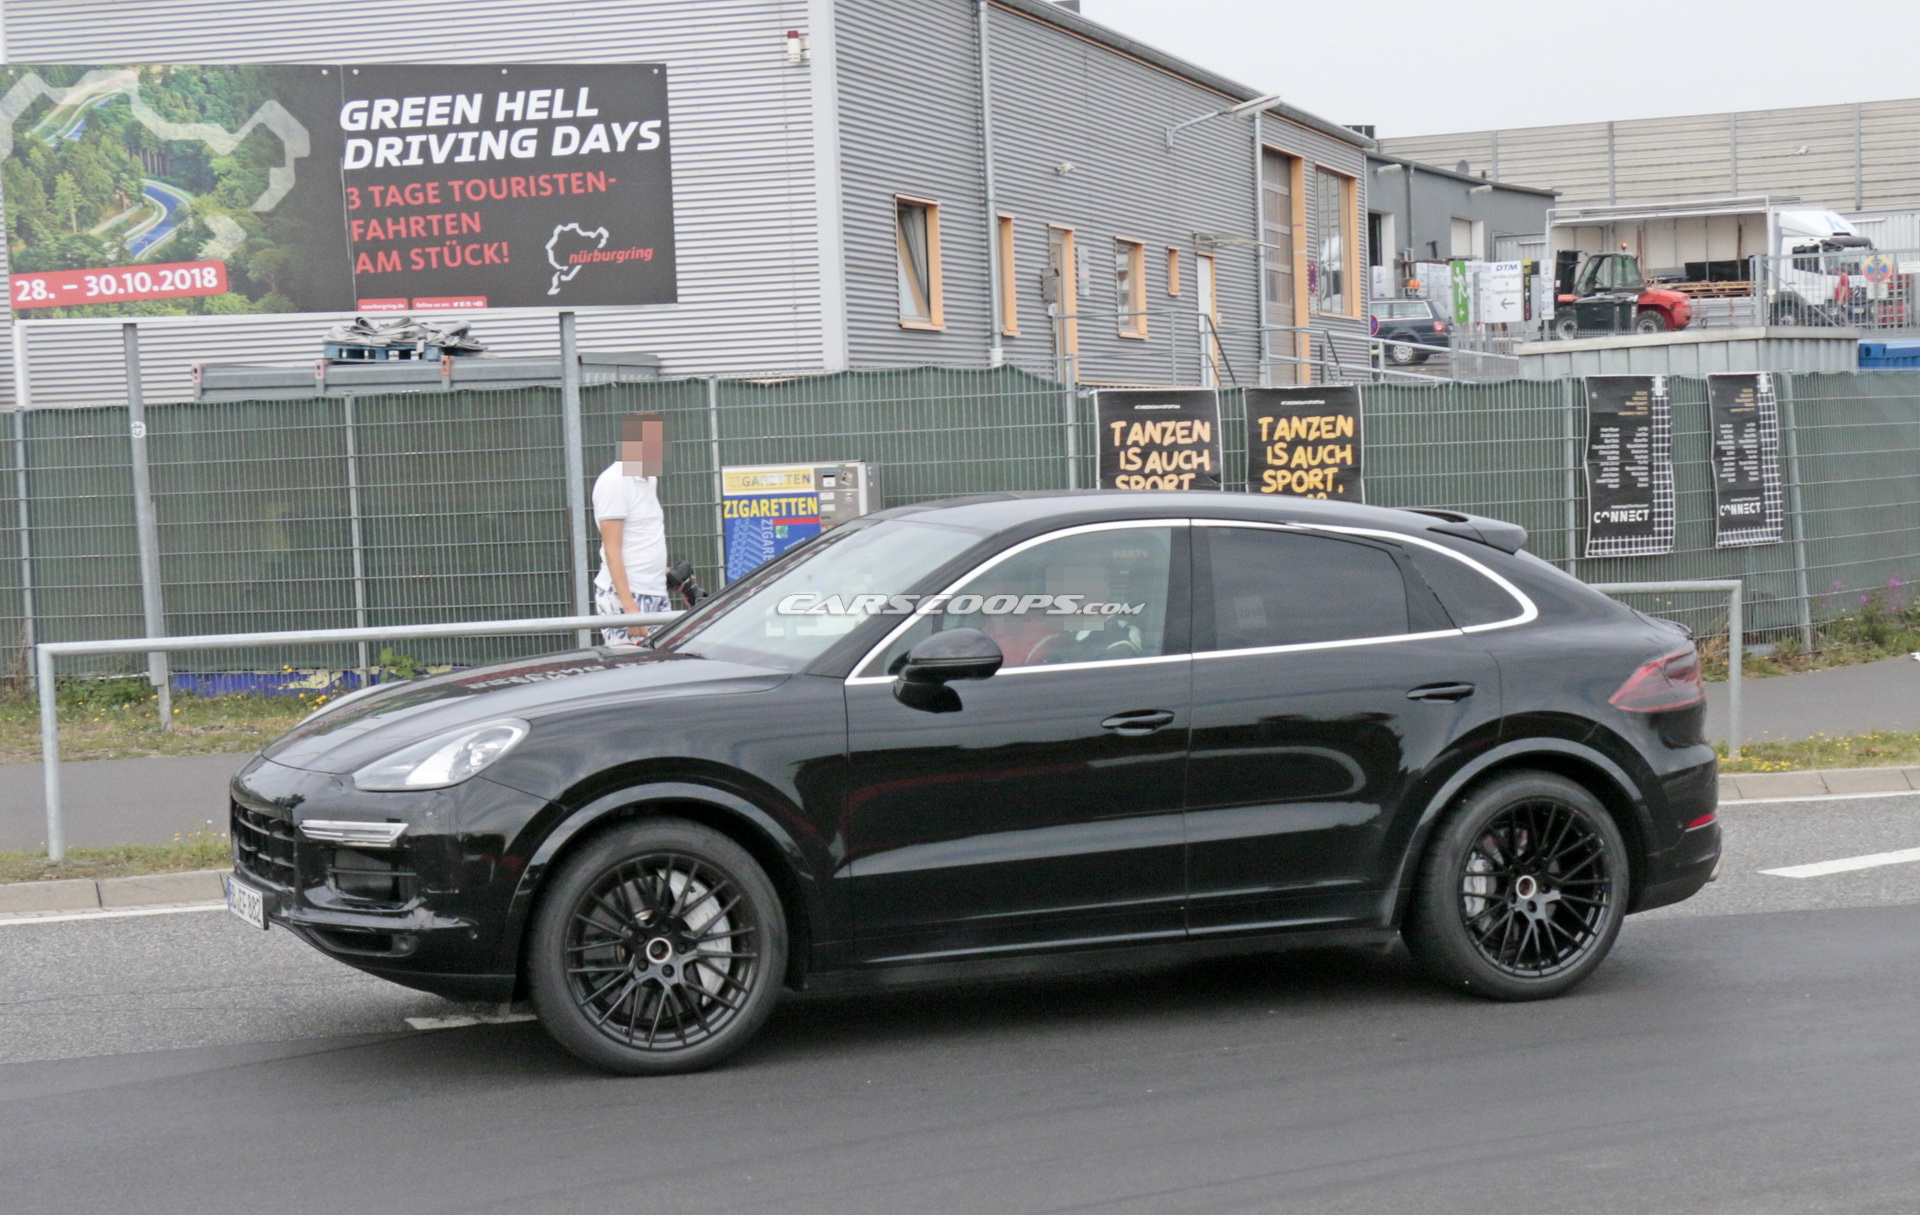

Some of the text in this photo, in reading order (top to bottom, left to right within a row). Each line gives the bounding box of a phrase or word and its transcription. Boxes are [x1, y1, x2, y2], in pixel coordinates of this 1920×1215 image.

[339, 87, 599, 132] GREEN HELL
[343, 120, 662, 170] DRIVING DAYS
[345, 170, 617, 210] 3 TAGE TOURISTEN-
[351, 211, 482, 242] FAHRTEN
[354, 241, 510, 275] AM STÜCK!
[568, 246, 654, 264] nürburgring
[1496, 264, 1518, 272] DTM
[15, 279, 56, 301] 28.
[84, 267, 218, 297] 30.10.2018
[1110, 419, 1211, 447] TANZEN
[1257, 414, 1354, 442] TANZEN
[1119, 447, 1211, 475] IS AUCH
[1266, 442, 1353, 469] IS AUCH
[723, 497, 819, 519] ZIGARETTEN
